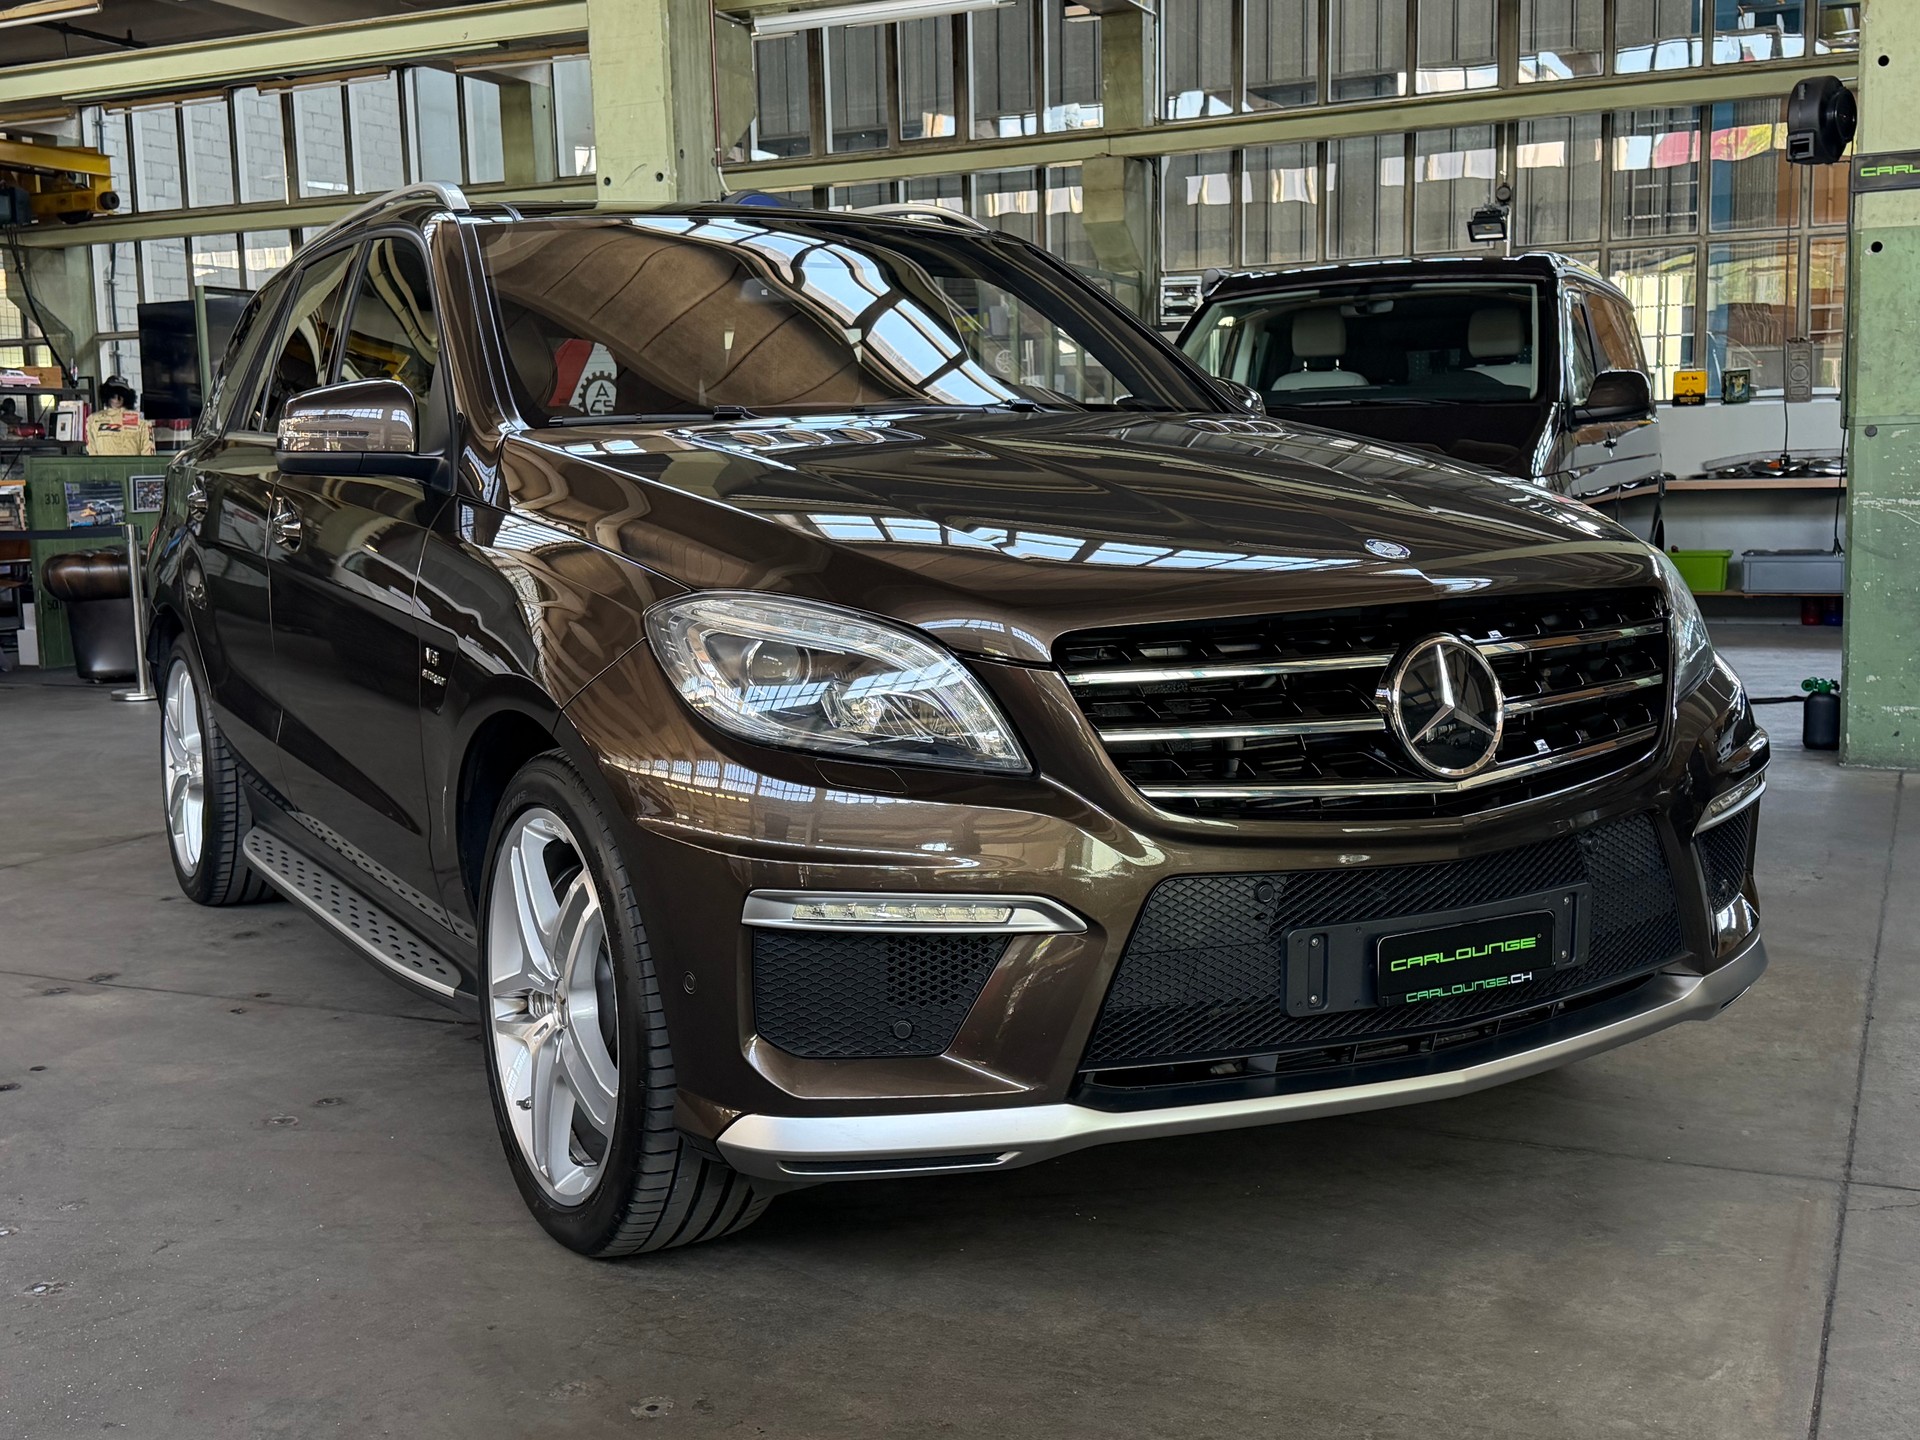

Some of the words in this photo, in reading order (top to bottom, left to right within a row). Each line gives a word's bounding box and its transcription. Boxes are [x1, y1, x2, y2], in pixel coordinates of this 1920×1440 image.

[1861, 165, 1920, 176] CARL
[595, 382, 609, 398] A
[1391, 937, 1536, 972] CARLOUNGE
[1406, 972, 1533, 1003] CARLOUNGE.CH
